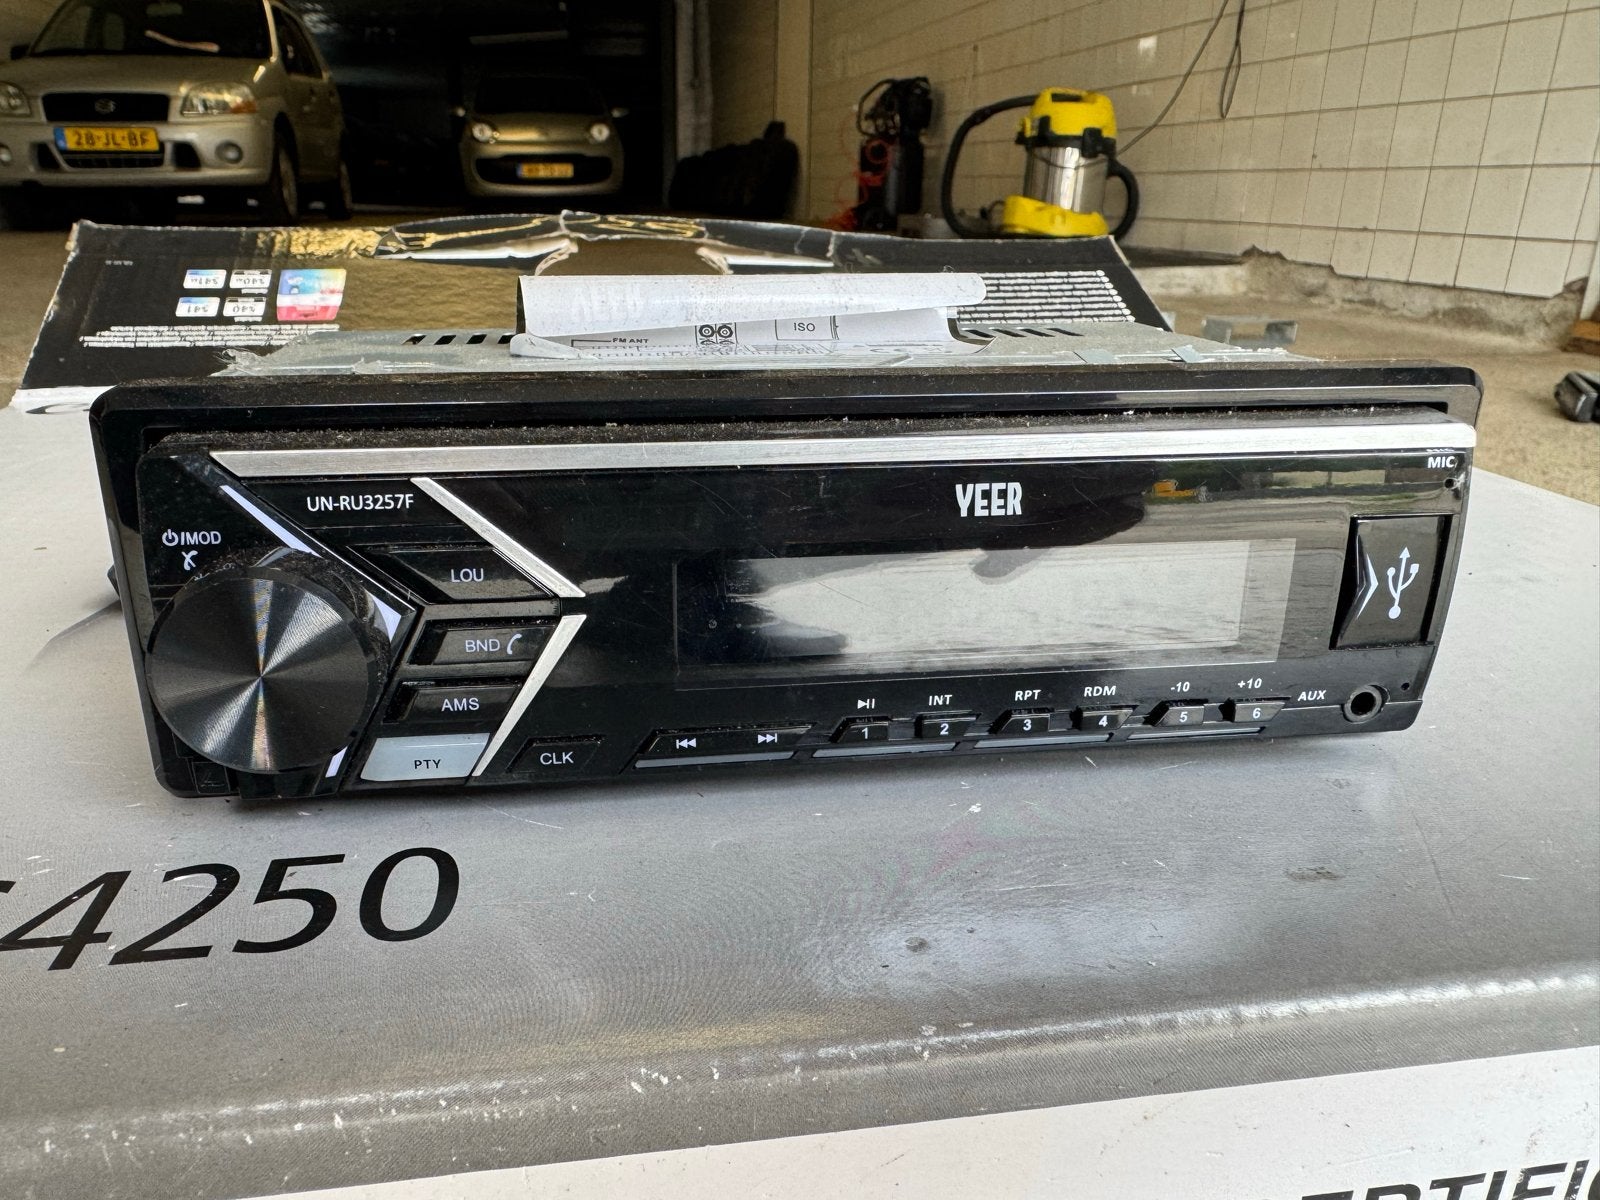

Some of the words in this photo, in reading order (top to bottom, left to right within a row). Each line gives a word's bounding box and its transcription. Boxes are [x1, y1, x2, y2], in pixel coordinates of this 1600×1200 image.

[793, 321, 816, 332] ISO
[1427, 455, 1457, 469] MIC
[306, 493, 414, 513] UN-RU3257F
[954, 481, 1023, 518] YEER
[450, 567, 484, 583] LOU
[464, 638, 501, 654] BND
[1170, 681, 1191, 693] -10
[1237, 677, 1263, 690] +10
[1014, 689, 1042, 702] RPT
[1083, 685, 1117, 698] RDM
[1297, 689, 1327, 702] AUX
[441, 697, 480, 712] AMS
[928, 694, 953, 707] INT
[1179, 711, 1188, 723] 5
[1252, 708, 1261, 720] 6
[1022, 719, 1032, 732] 3
[1098, 716, 1108, 728] 4
[861, 727, 869, 740] 1
[939, 722, 949, 737] 2
[413, 759, 442, 771] PTY
[539, 751, 574, 766] CLK
[0, 847, 460, 970] 4250
